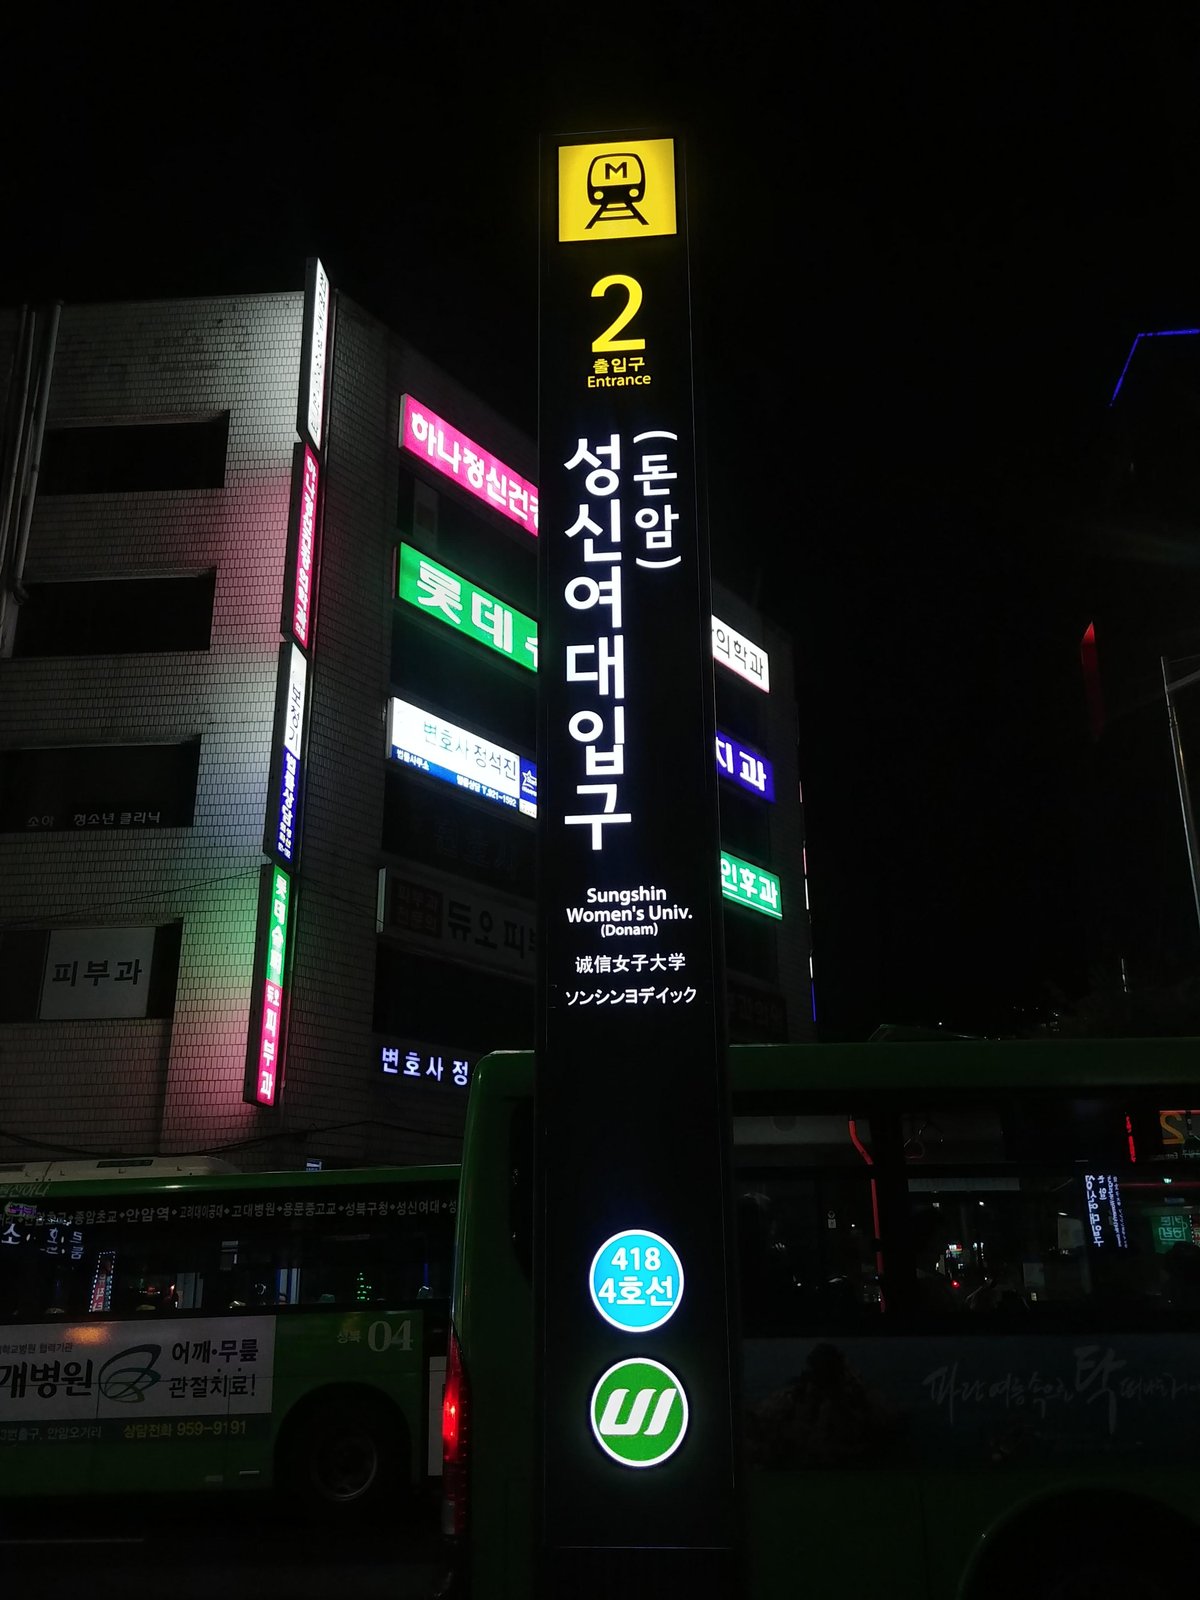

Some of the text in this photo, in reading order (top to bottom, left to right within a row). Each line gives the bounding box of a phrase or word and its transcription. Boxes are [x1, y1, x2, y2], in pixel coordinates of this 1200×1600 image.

[604, 161, 628, 180] M
[590, 274, 646, 353] 2
[592, 356, 645, 374] 출입구
[587, 374, 651, 388] Entrance
[633, 430, 682, 569] (돈암)
[564, 433, 632, 851] 성신여대입구
[423, 721, 469, 760] 변호사
[474, 744, 516, 782] 정석진
[119, 810, 161, 826] 클리닉
[586, 886, 667, 906] Sungshin
[566, 904, 693, 923] Women's Univ.
[600, 922, 659, 938] (Donam)
[52, 958, 142, 987] 피부과
[575, 952, 686, 974] 诚信女子大学
[380, 1046, 444, 1082] 변호사
[126, 1206, 170, 1223] 안암역
[231, 1202, 276, 1218] 고대병원
[283, 1201, 337, 1217] 용문중고교
[345, 1200, 388, 1217] 성북구청
[396, 1199, 440, 1216] 성신여대
[611, 1247, 661, 1271] 418
[598, 1276, 674, 1306] 4호선
[368, 1320, 414, 1352] 04
[169, 1372, 256, 1399] 관절치료!
[123, 1423, 172, 1440] 상담전화
[176, 1420, 248, 1437] 959-9191
